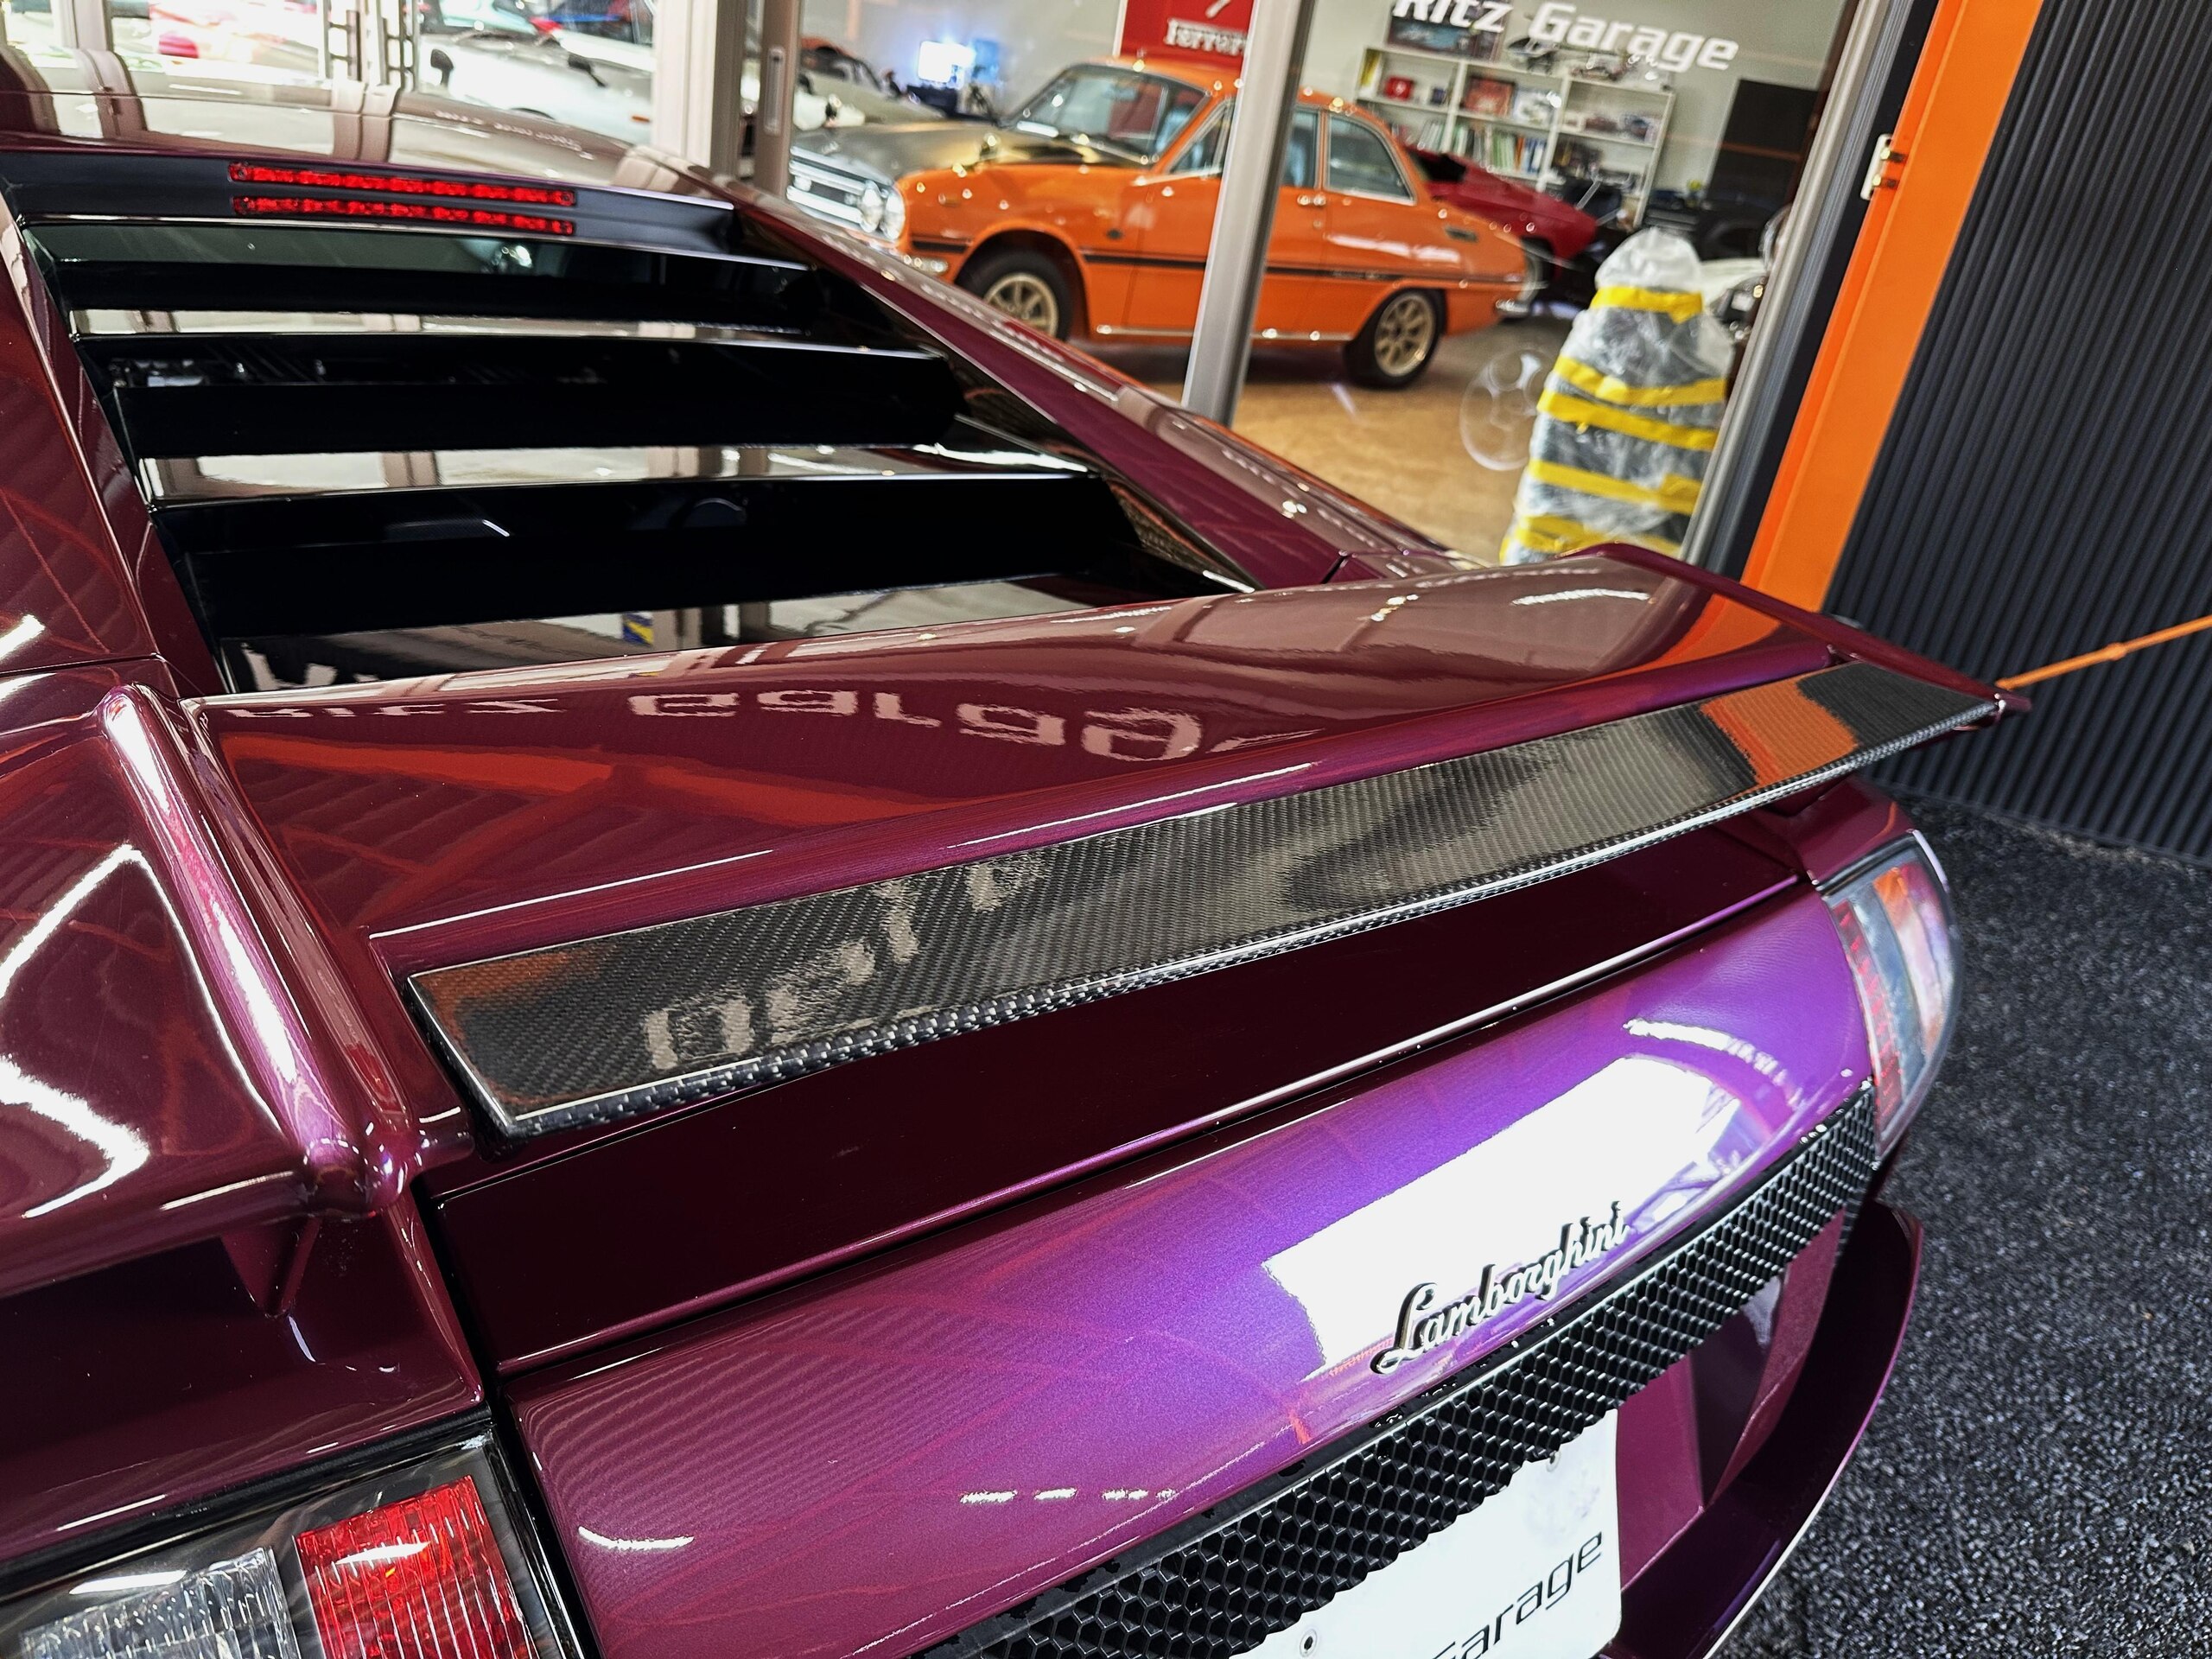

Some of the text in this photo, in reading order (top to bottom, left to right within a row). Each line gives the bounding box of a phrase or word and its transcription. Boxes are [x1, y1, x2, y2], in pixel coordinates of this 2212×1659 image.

[1528, 2, 1739, 73] Garage
[1370, 1200, 1630, 1375] Lamborghini
[1432, 1531, 1602, 1659] arage
